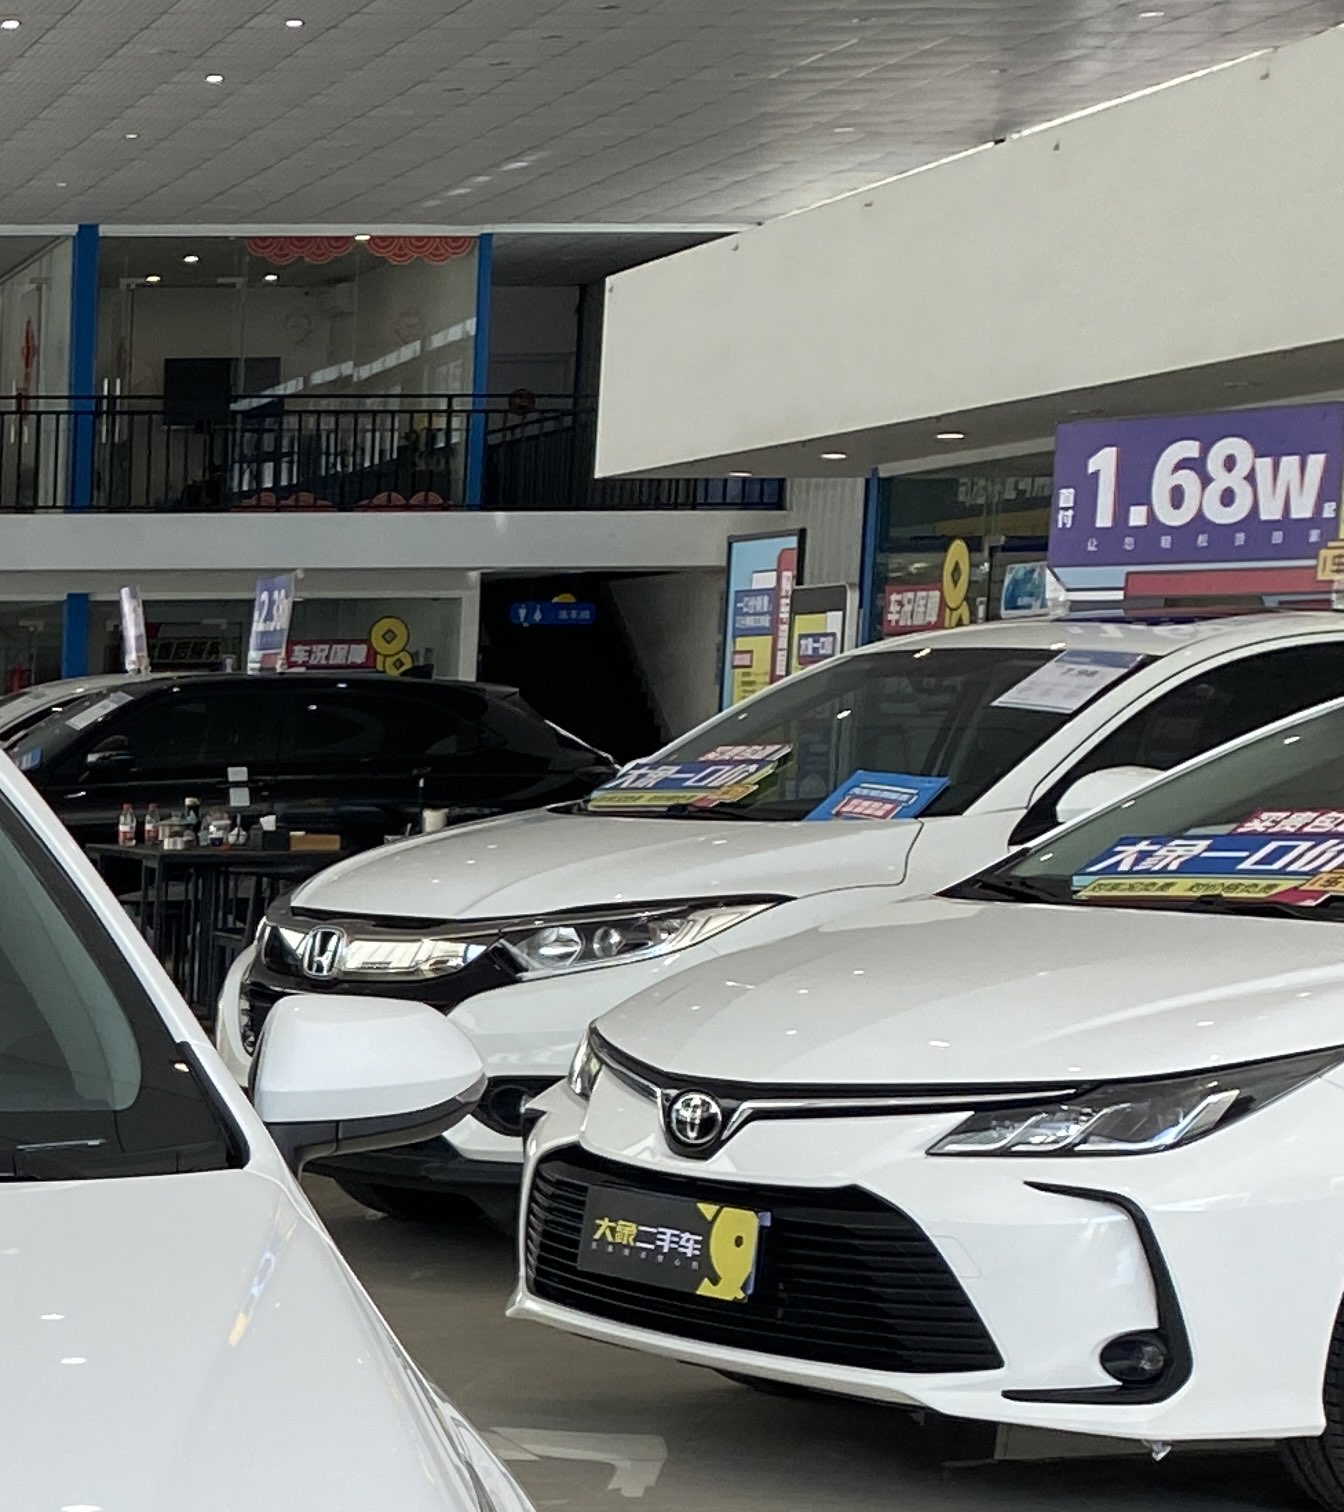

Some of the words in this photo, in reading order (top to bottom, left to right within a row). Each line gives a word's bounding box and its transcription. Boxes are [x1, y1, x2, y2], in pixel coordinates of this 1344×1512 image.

[292, 644, 368, 665] 车况保障
[1235, 811, 1344, 833] 买贵包
[593, 1217, 703, 1258] 大象二手车
